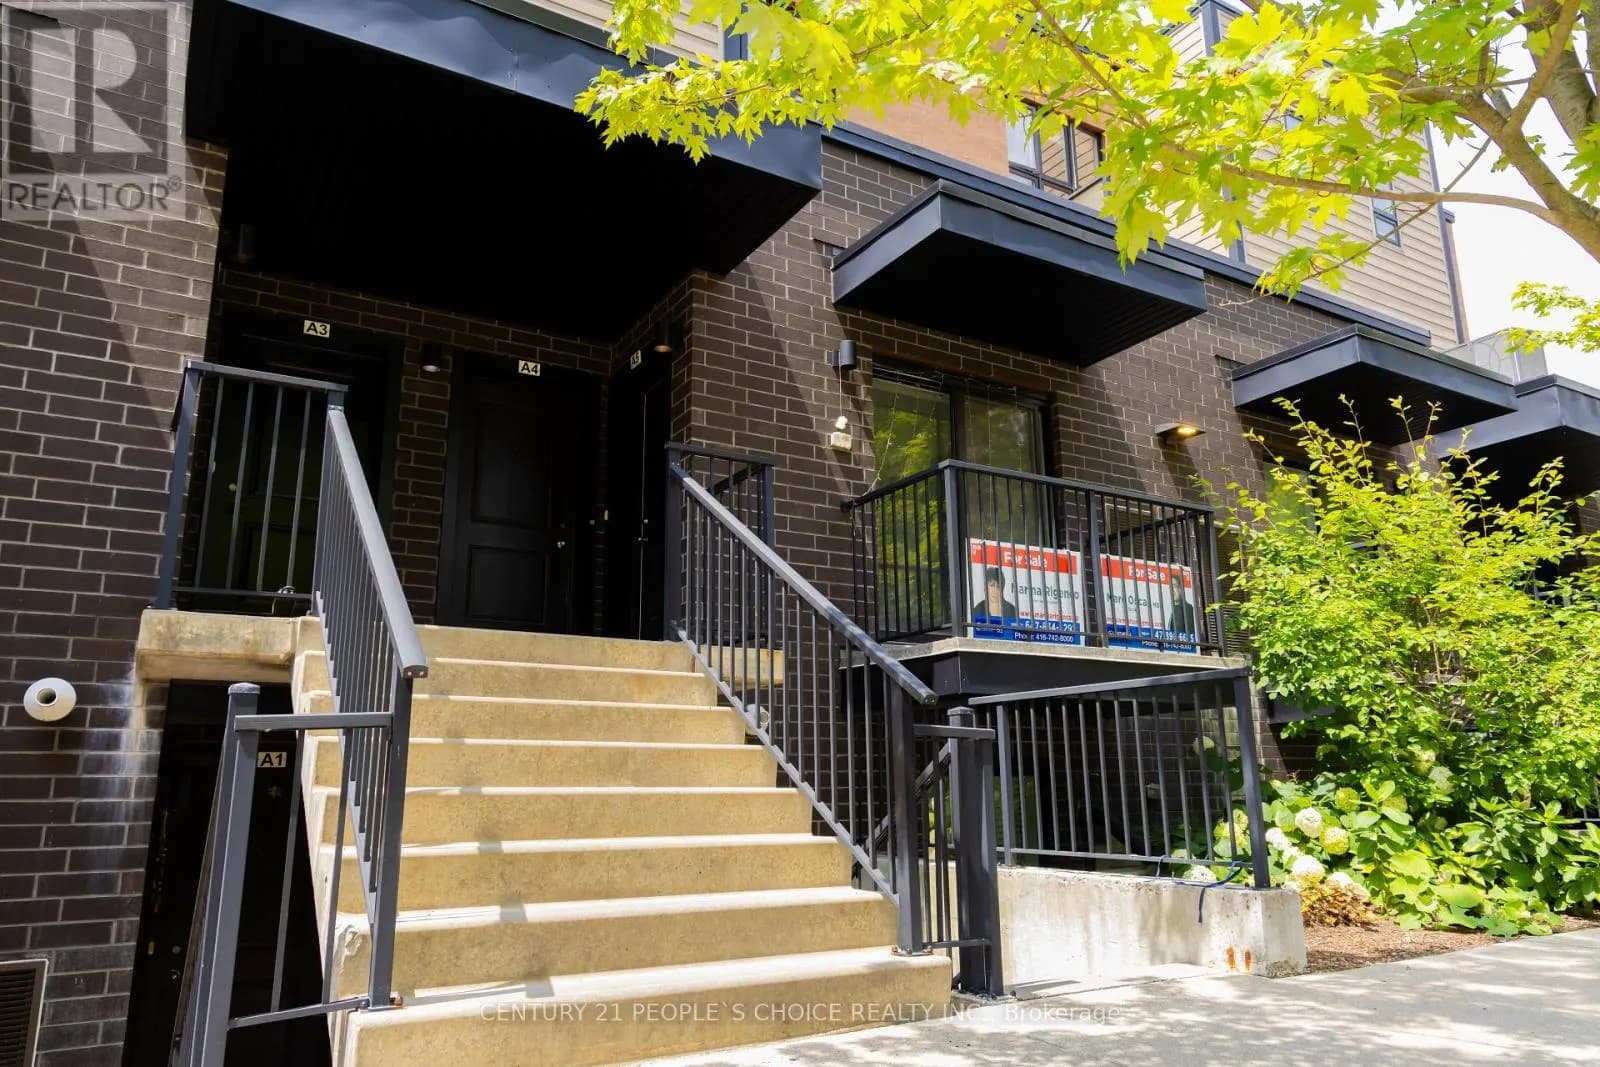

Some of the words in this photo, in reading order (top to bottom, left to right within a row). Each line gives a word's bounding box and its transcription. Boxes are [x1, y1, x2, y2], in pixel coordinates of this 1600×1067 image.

[306, 322, 328, 336] A3
[521, 362, 538, 375] A4
[1004, 551, 1023, 565] Fr
[1025, 553, 1048, 568] ale
[1145, 567, 1166, 581] Sae
[261, 753, 283, 767] A1
